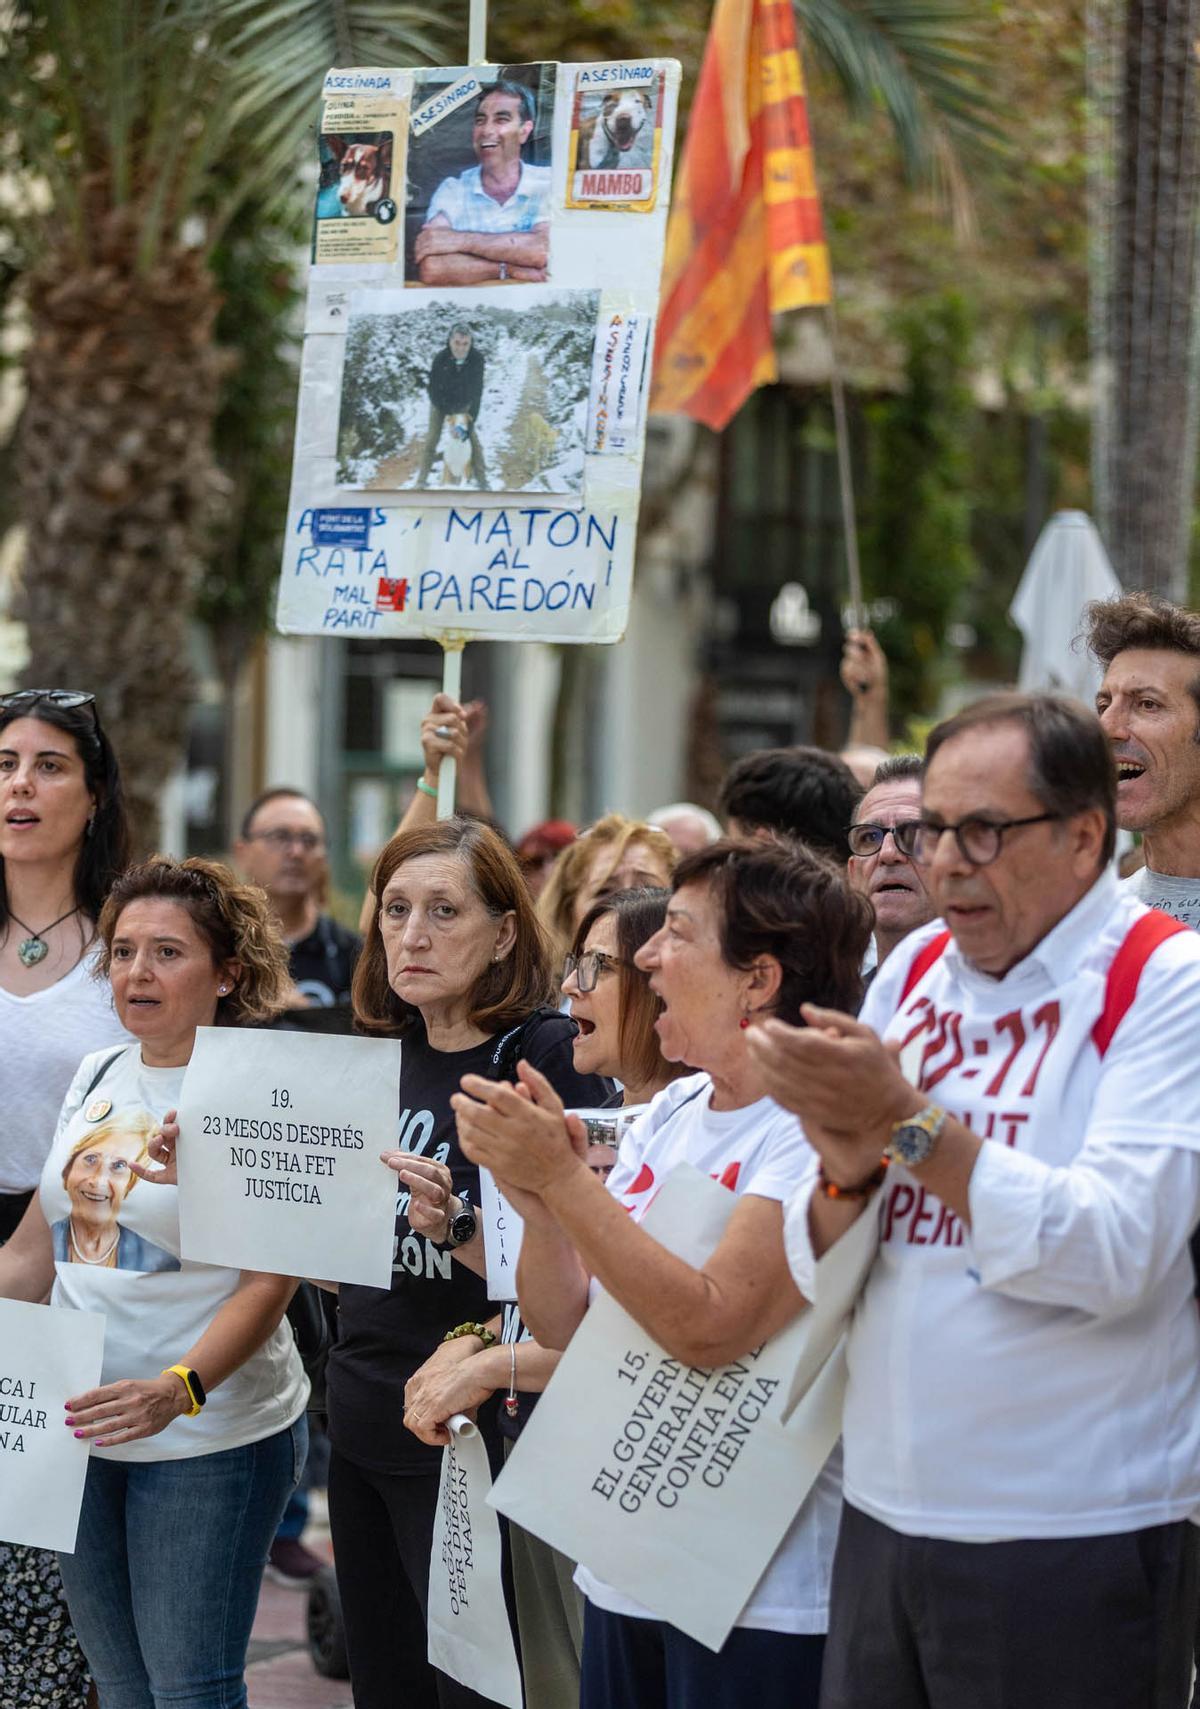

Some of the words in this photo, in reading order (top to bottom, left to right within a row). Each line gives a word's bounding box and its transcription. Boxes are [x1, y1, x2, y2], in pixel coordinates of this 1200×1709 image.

[325, 74, 391, 88] ASESINADA
[580, 64, 653, 83] ASESINADO
[412, 79, 477, 128] ASESINADO
[581, 174, 642, 195] MAMBO
[446, 507, 618, 551] MATÓN
[295, 545, 388, 576] RATA
[488, 548, 530, 571] AL
[333, 585, 371, 604] MAL
[417, 569, 596, 613] PAREDÓN
[271, 1089, 293, 1109] 19.
[203, 1116, 221, 1135] 23
[225, 1117, 282, 1142] MESOS
[286, 1123, 364, 1150] DESPRÉS
[230, 1147, 257, 1168] NO
[261, 1150, 302, 1173] S'HA
[305, 1155, 336, 1176] FET
[245, 1177, 322, 1205] JUSTÍCIA
[618, 1350, 650, 1386] 15.
[28, 1382, 36, 1399] I
[619, 1366, 716, 1514] GENERALIT
[656, 1406, 726, 1509] CONFIA
[713, 1361, 750, 1404] EN
[702, 1375, 780, 1489] CIÈNCIA
[592, 1467, 624, 1501] EL
[455, 1557, 469, 1608] FER
